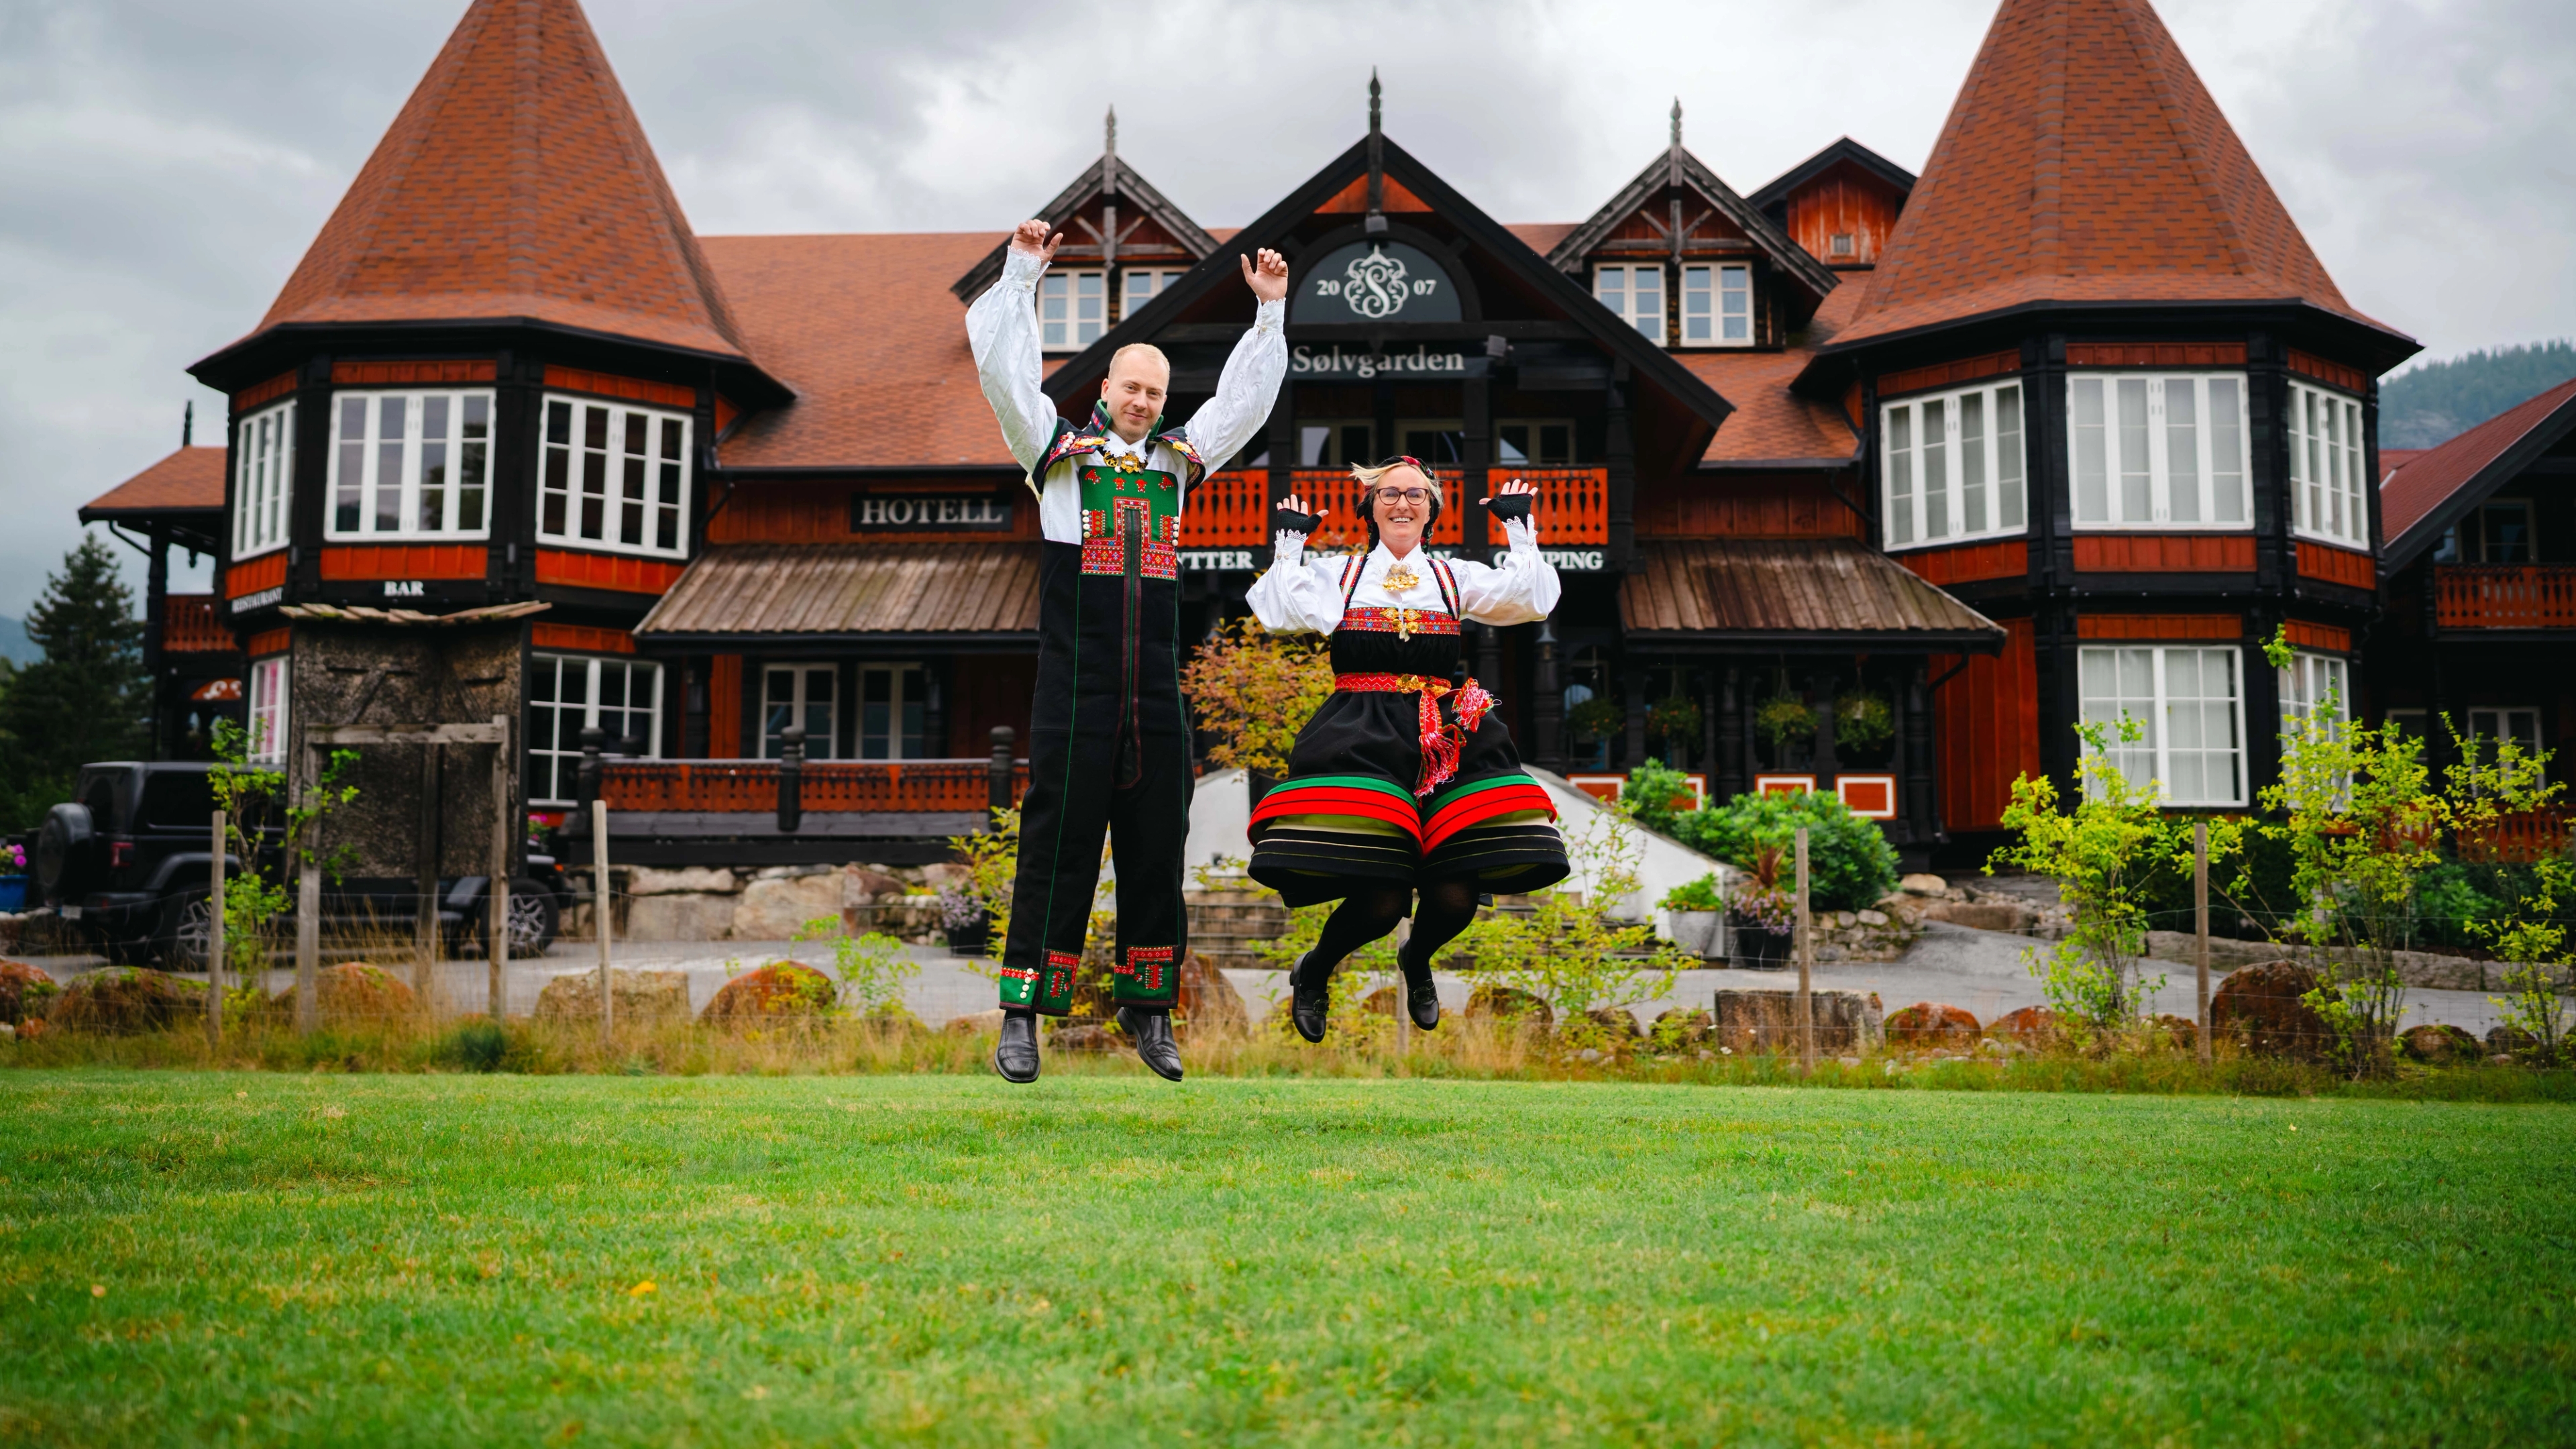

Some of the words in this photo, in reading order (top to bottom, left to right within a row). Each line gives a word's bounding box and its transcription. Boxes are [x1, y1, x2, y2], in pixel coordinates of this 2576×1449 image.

[1316, 279, 1341, 296] 20
[1413, 279, 1437, 296] 07
[1292, 345, 1465, 378] Sølvgarden
[860, 498, 1004, 525] HOTELL
[1176, 551, 1255, 570] YTTER
[1493, 550, 1604, 570] CPING
[384, 580, 425, 596] BAR
